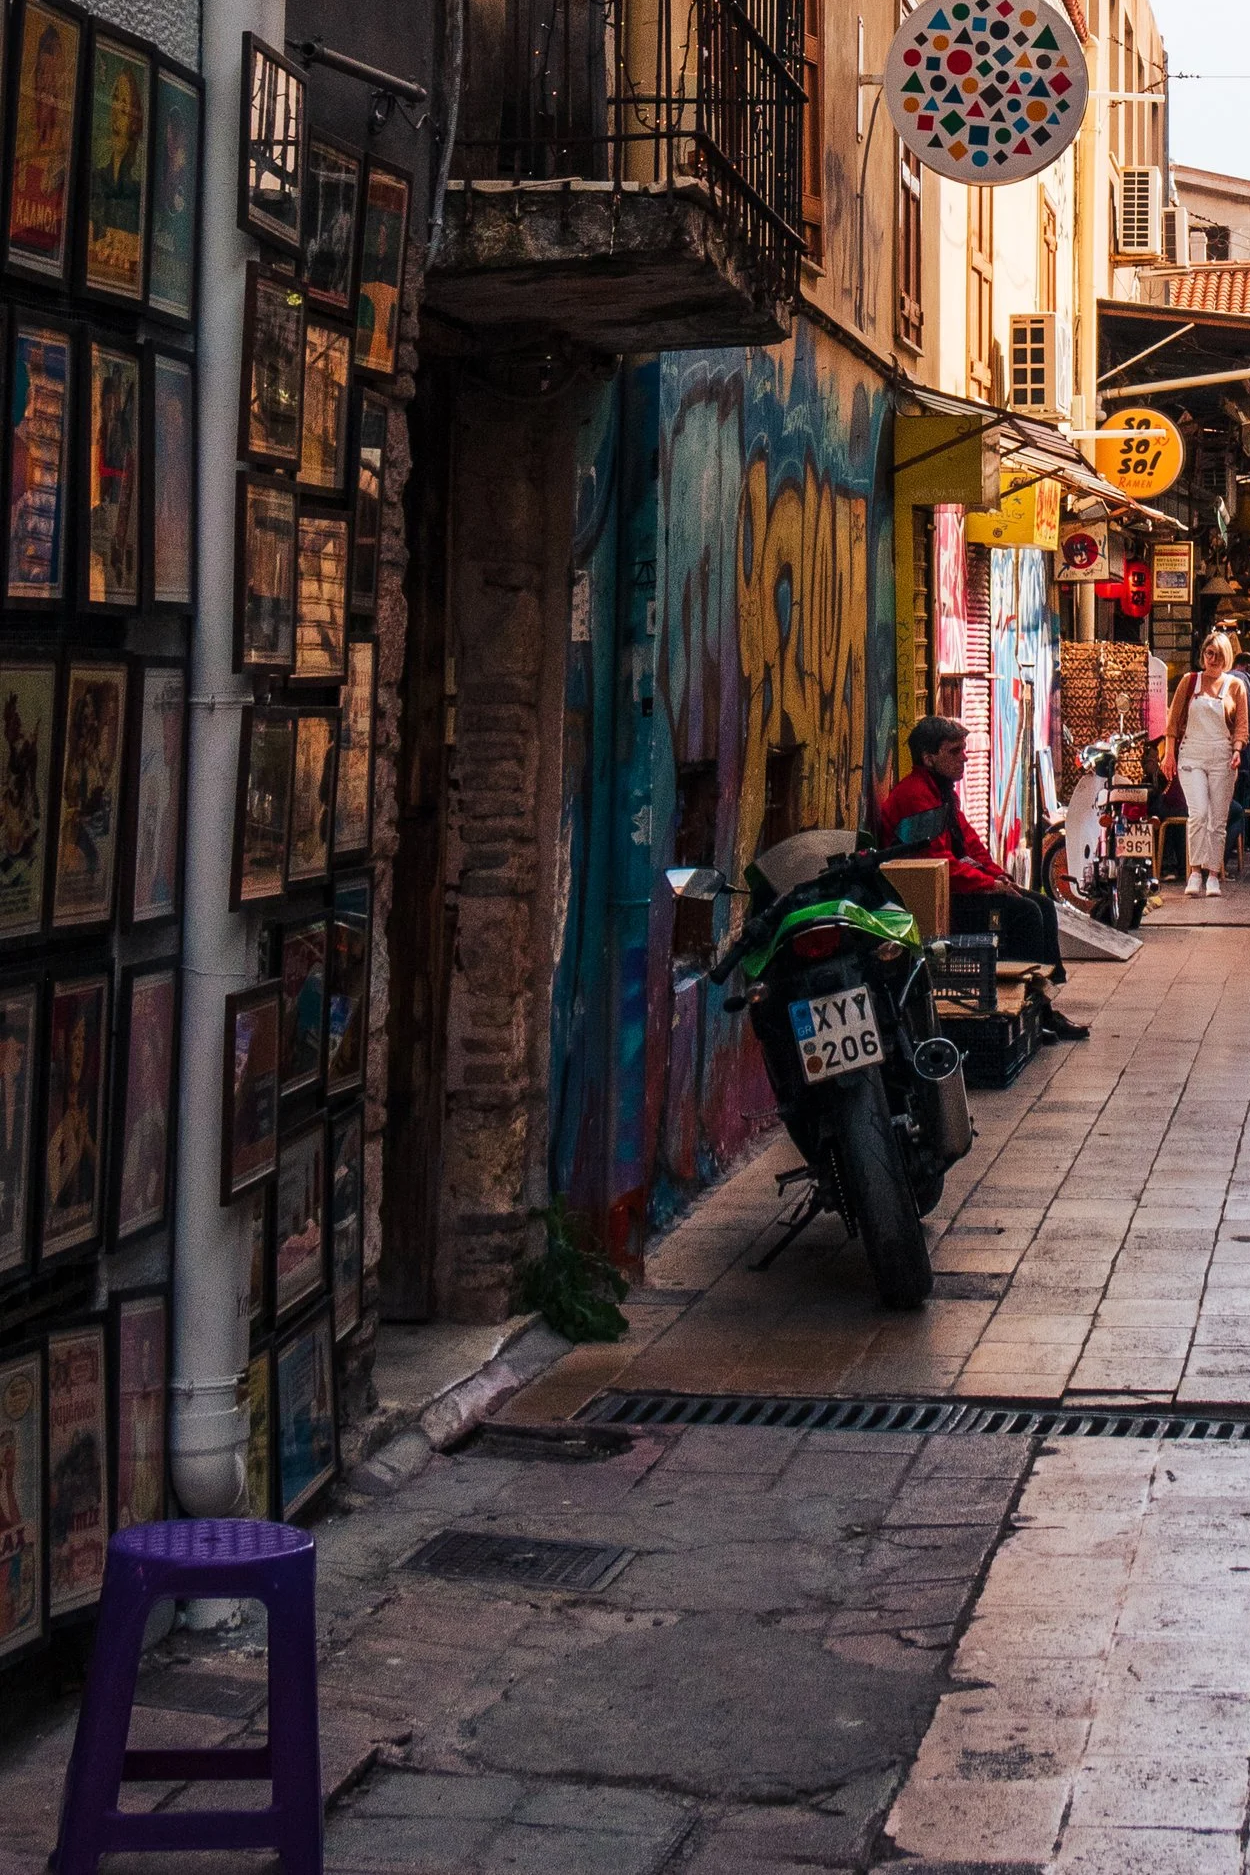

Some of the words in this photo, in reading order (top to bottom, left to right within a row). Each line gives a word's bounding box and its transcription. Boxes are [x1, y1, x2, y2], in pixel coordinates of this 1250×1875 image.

[1119, 437, 1151, 454] SO
[1117, 450, 1162, 477] SO!
[813, 993, 867, 1032] XYY
[797, 1025, 813, 1037] GR
[821, 1030, 878, 1070] 206
